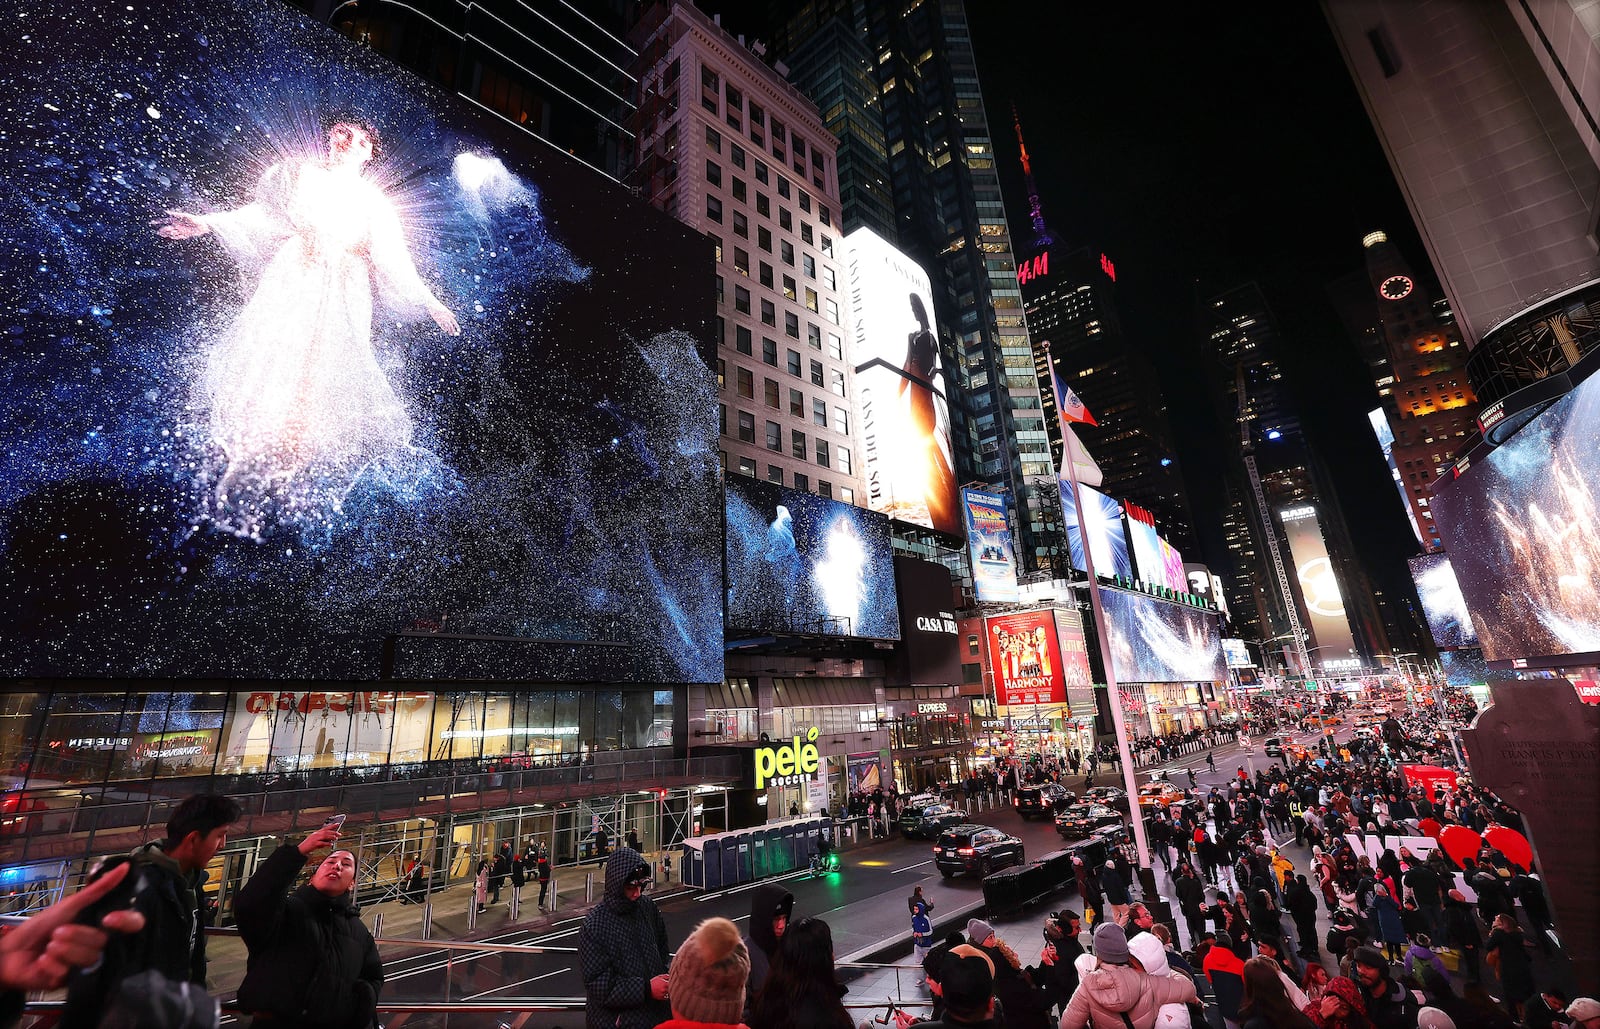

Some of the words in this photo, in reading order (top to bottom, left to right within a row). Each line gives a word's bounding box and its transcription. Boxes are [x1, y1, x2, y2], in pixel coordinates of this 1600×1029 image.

[1017, 251, 1048, 285] H&M
[917, 617, 943, 633] CASA
[1004, 677, 1053, 689] HARMONY
[918, 703, 947, 713] EXPRESS
[981, 720, 1005, 728] GIFTS
[755, 727, 819, 789] pelé
[770, 773, 812, 787] SOCCER
